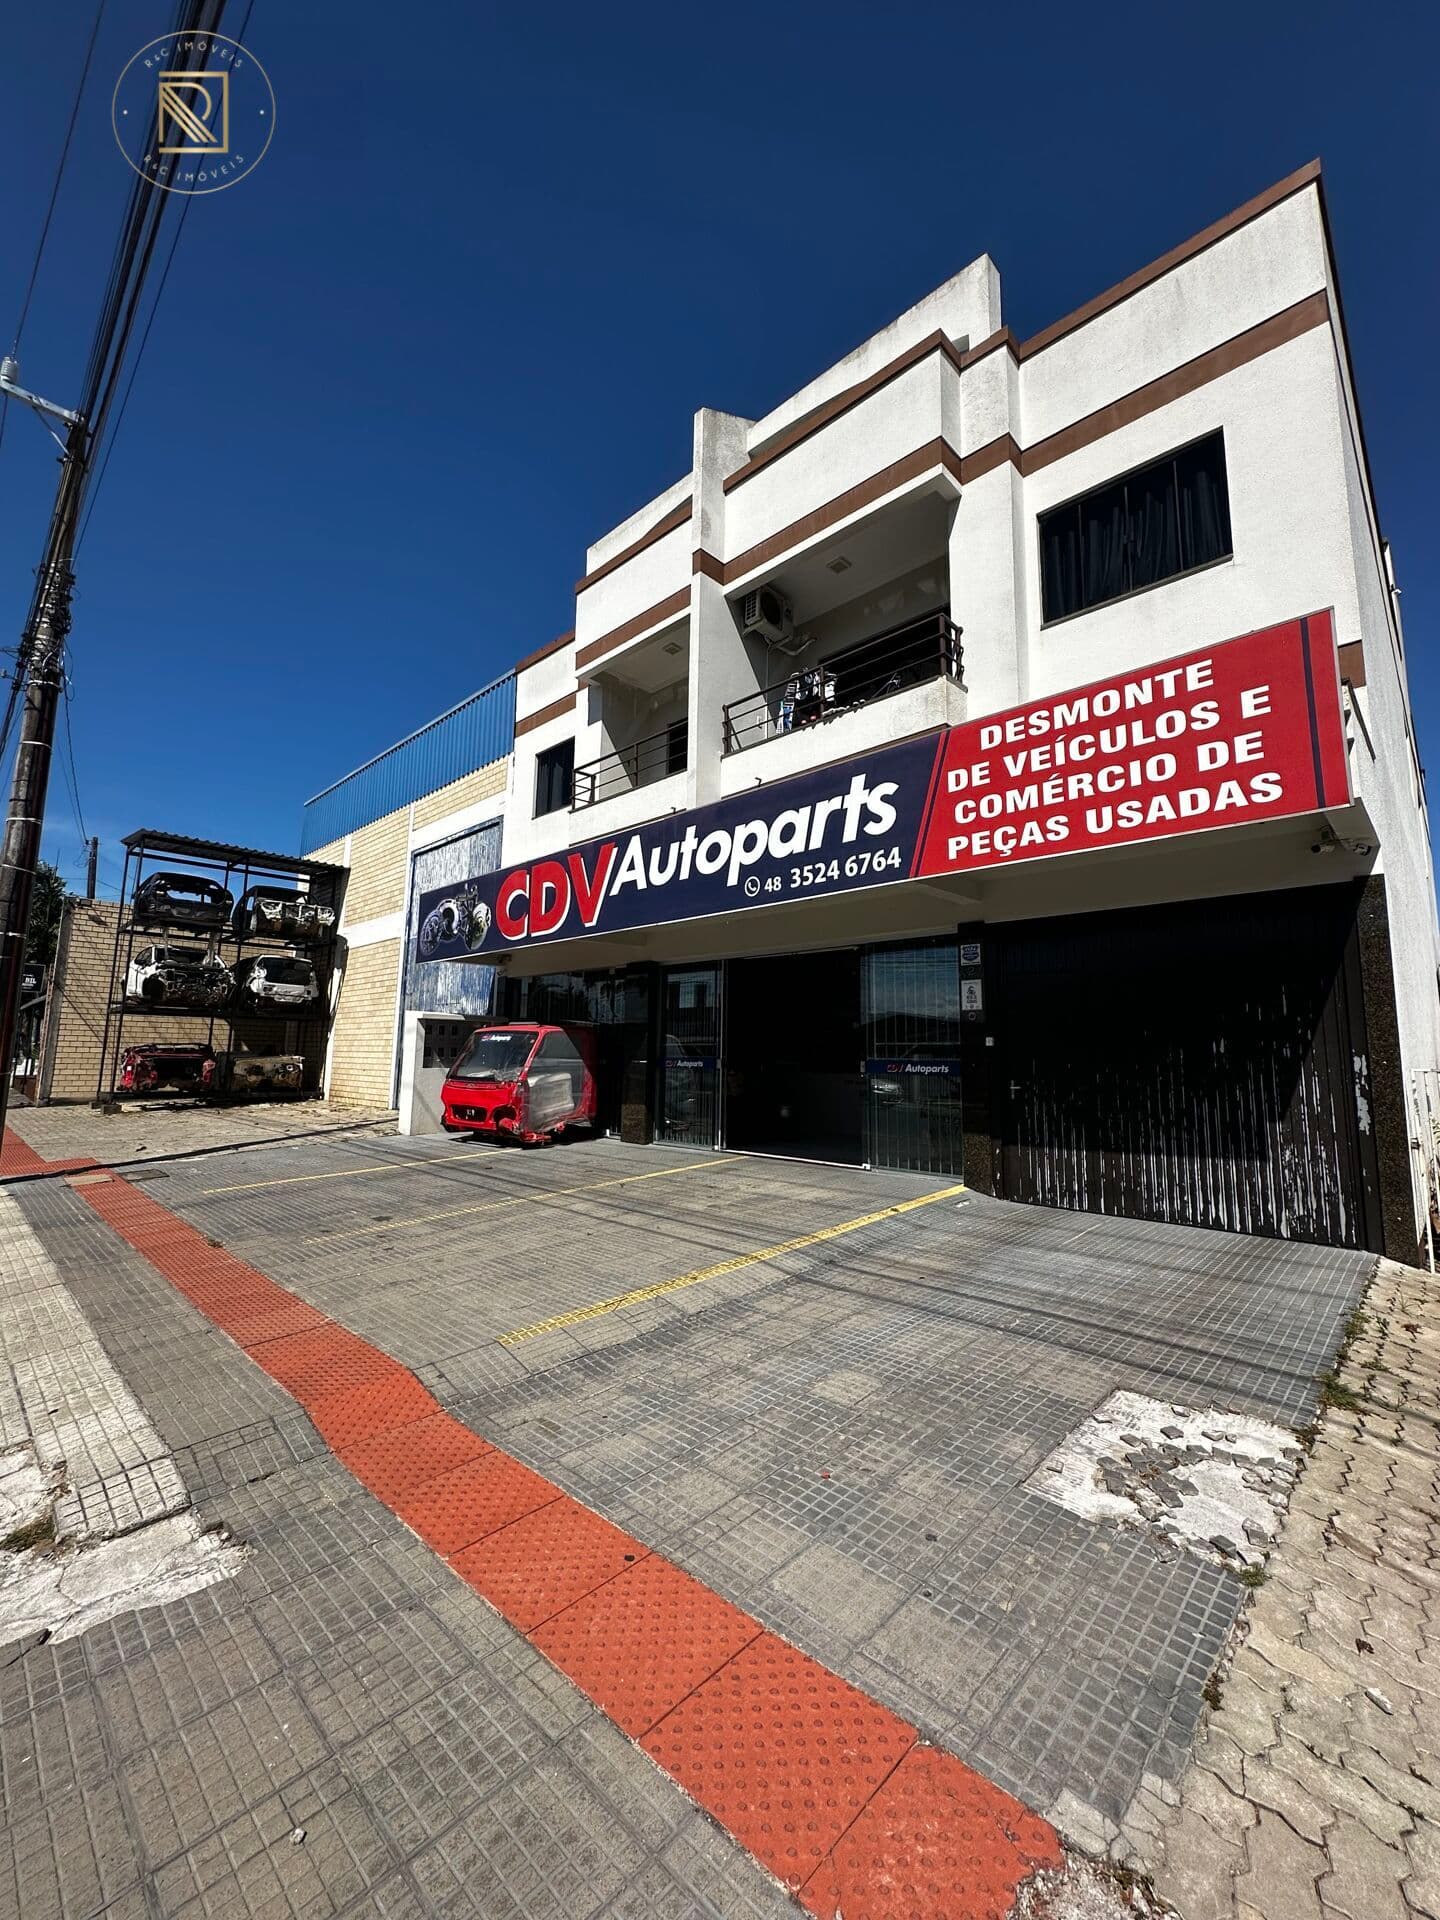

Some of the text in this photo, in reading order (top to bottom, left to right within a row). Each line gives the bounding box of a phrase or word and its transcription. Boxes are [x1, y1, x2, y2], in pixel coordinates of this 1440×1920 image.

[947, 686, 1272, 793] DE VEÍCULOS E
[980, 659, 1214, 751] DESMONTE
[948, 772, 1283, 860] PEÇAS USADAS
[954, 730, 1265, 825] COMÉRCIO DE
[495, 774, 900, 941] CDV Autoparts
[764, 847, 902, 892] 48 3524 6764
[905, 1063, 949, 1075] Autoparts
